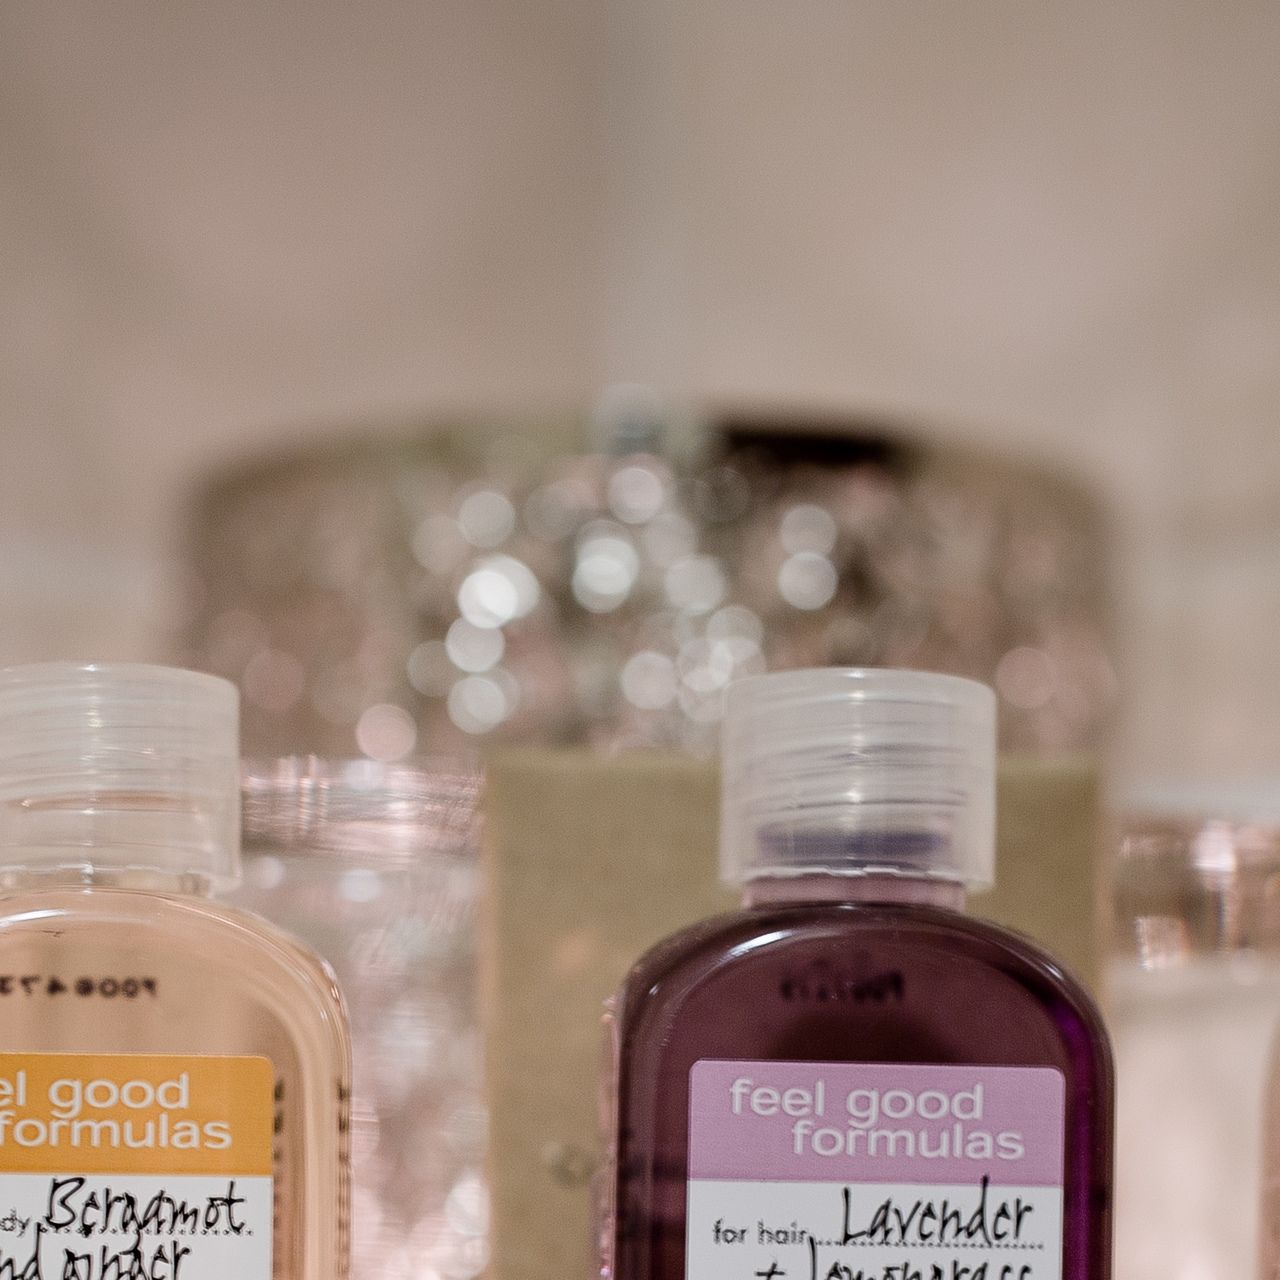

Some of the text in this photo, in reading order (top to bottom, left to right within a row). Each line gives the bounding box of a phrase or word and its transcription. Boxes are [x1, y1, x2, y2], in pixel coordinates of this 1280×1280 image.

[49, 1073, 189, 1120] good
[730, 1078, 984, 1129] feel good
[792, 1120, 1025, 1160] formulas
[46, 1176, 246, 1253] Bergamot
[713, 1174, 1033, 1246] for hair Lavender
